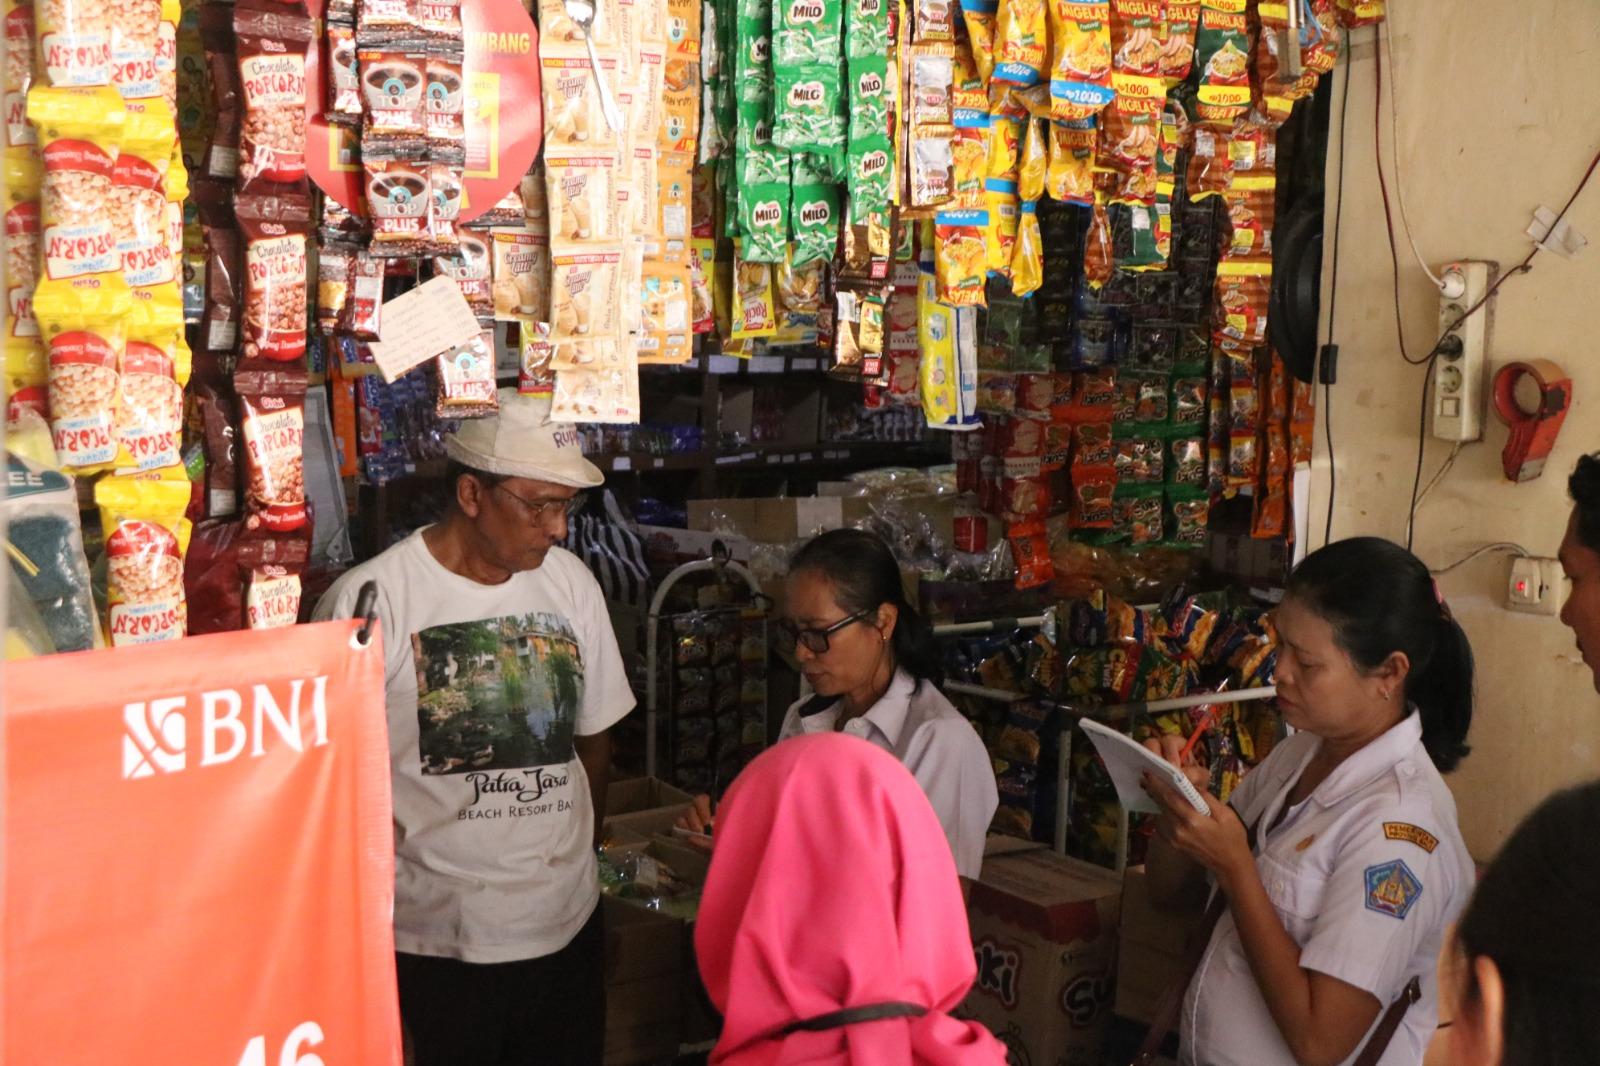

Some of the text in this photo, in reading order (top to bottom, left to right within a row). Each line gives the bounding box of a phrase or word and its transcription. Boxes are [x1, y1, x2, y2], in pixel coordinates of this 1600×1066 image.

[793, 6, 822, 19] MILO
[1061, 5, 1109, 22] MIGELAS
[1117, 0, 1158, 17] MIGELAS
[1167, 7, 1199, 20] GELAS
[1206, 12, 1245, 28] MIGELAS
[861, 79, 881, 93] MILO
[793, 87, 820, 101] MILO
[1117, 97, 1158, 112] MIGELAS
[1059, 131, 1096, 147] MIGELAS
[863, 155, 886, 173] MILO
[383, 203, 418, 216] TOP
[432, 204, 451, 217] OP
[755, 207, 780, 222] MILO
[802, 207, 828, 222] MILO
[384, 218, 420, 233] PLUS
[47, 232, 117, 260] OPCORN
[456, 280, 480, 295] LUS
[112, 609, 177, 635] OPCORN
[200, 674, 330, 767] BNI
[465, 767, 568, 805] Patra Jasa
[457, 800, 574, 821] BEACH RESORT BA
